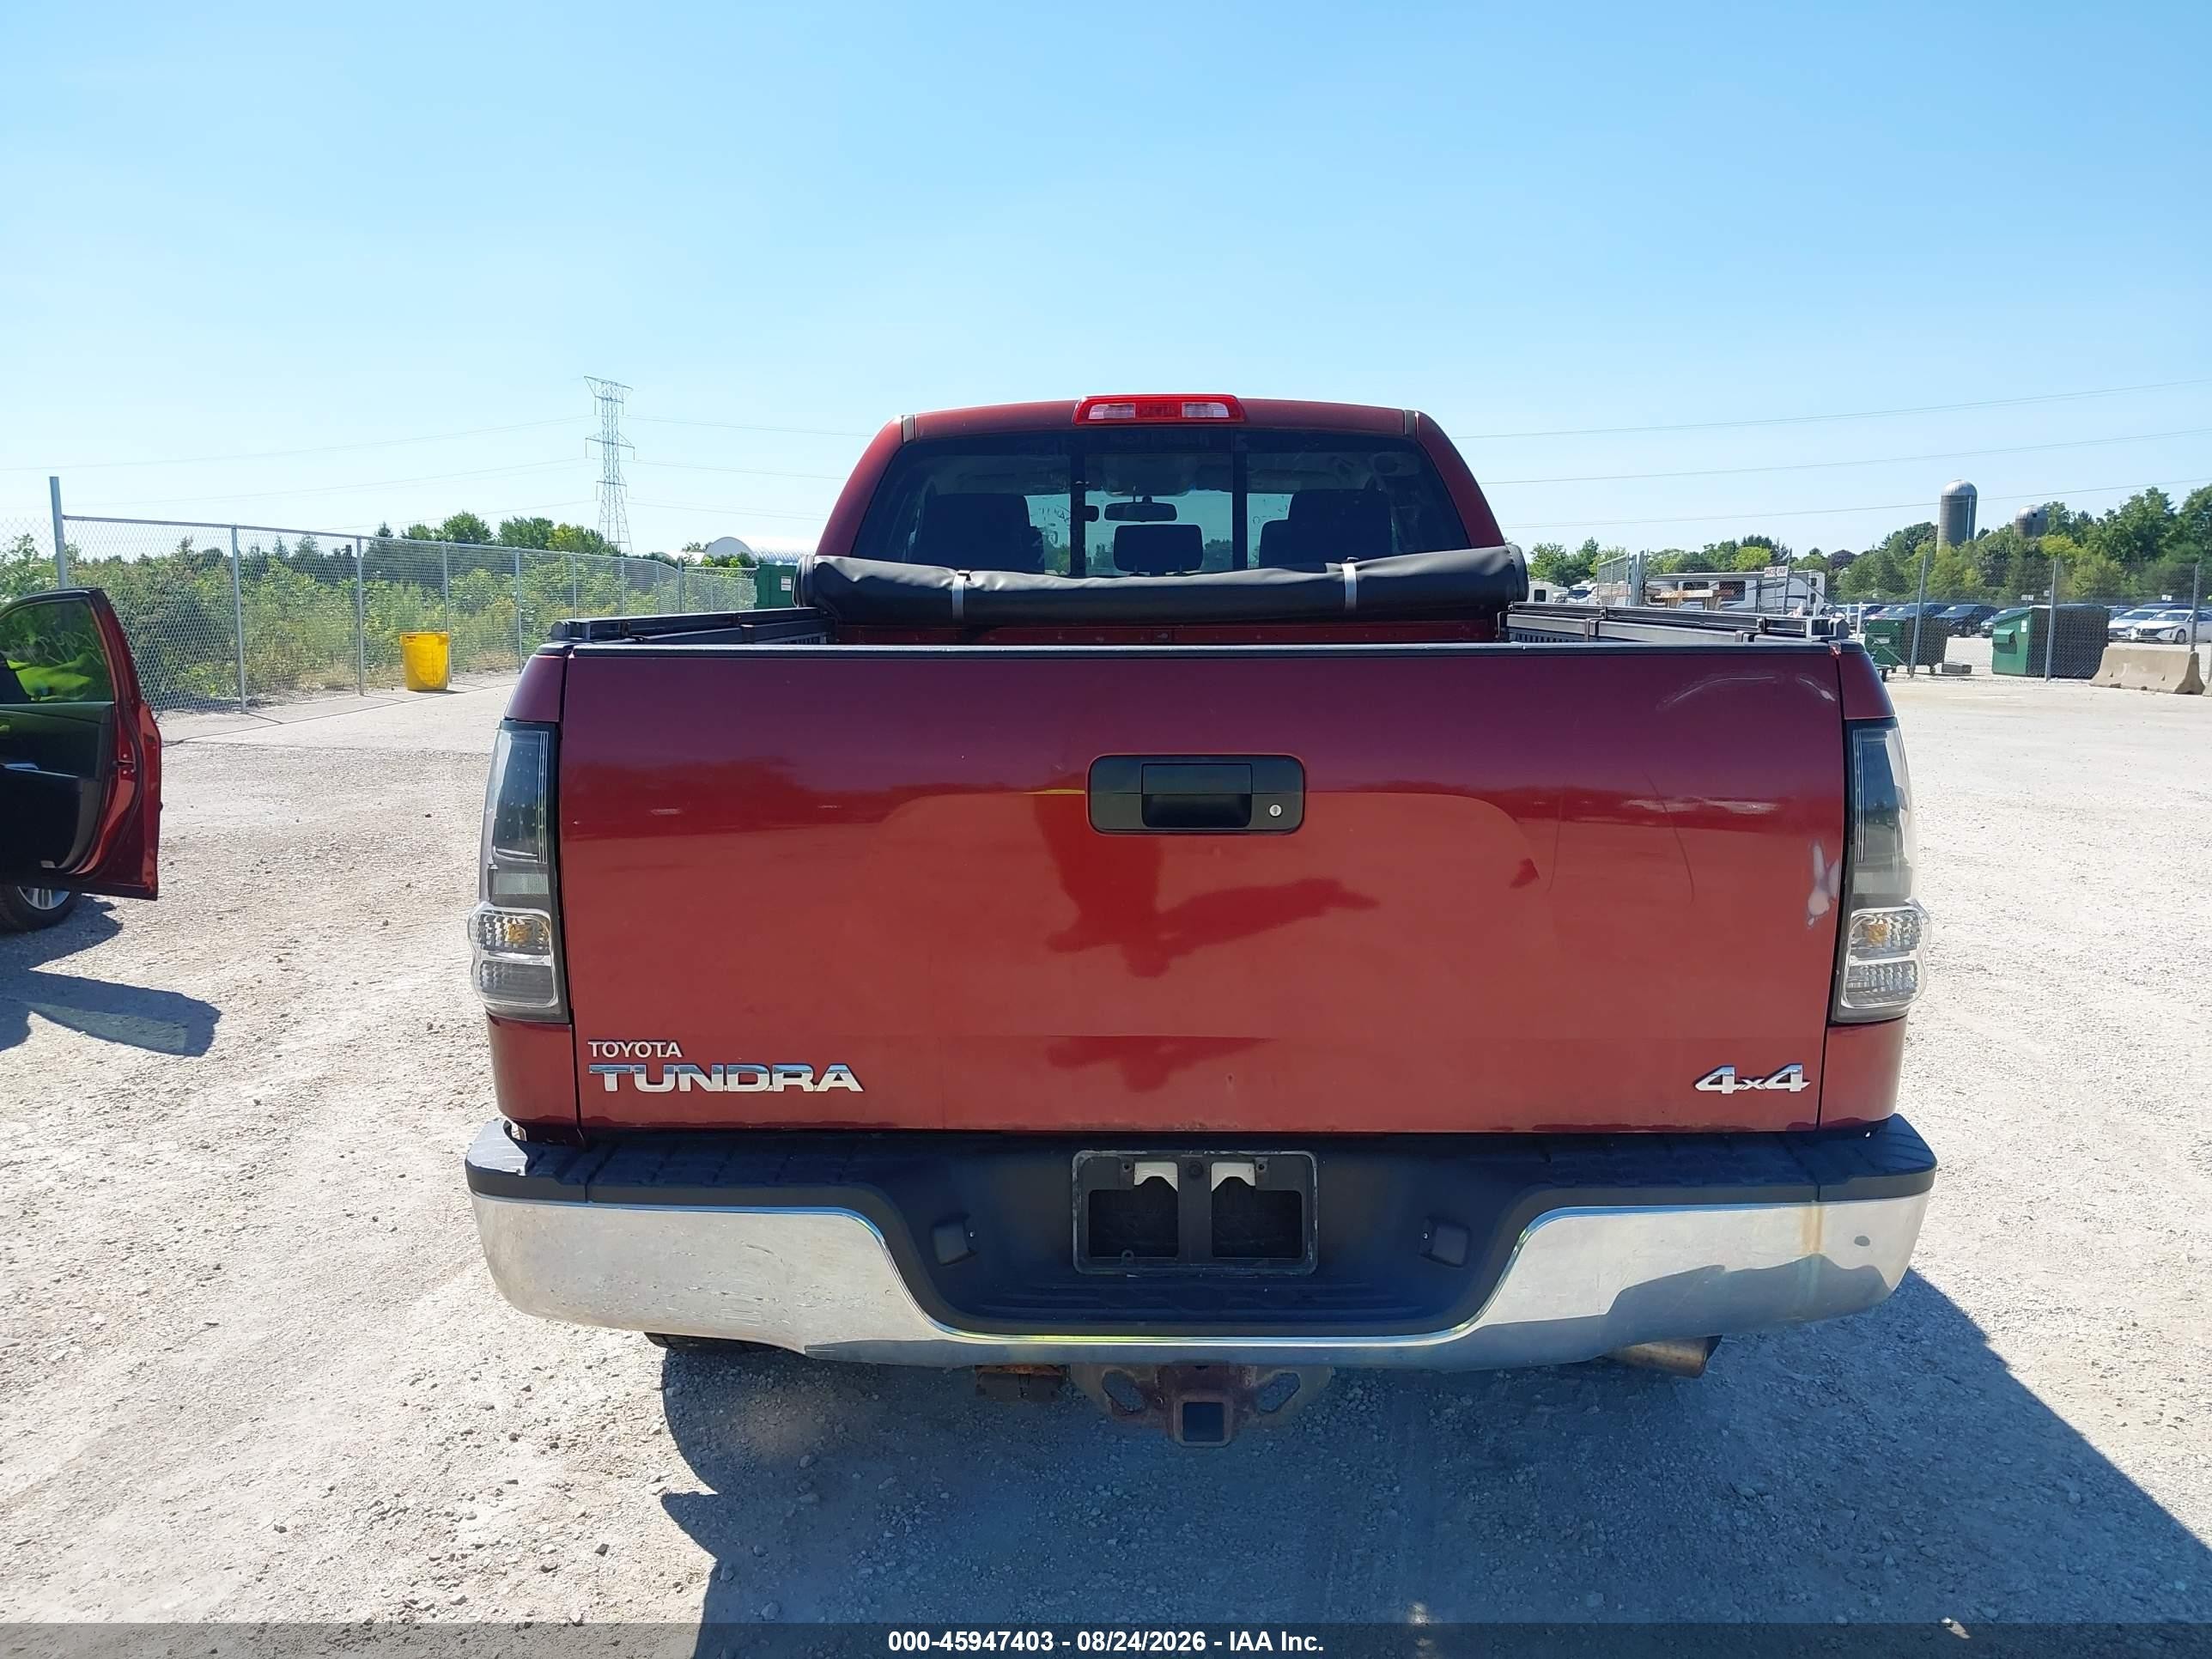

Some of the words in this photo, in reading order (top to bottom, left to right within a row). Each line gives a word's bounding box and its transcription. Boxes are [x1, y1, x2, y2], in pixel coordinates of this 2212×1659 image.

[587, 1041, 683, 1058] TOYOTA
[588, 1064, 865, 1092] TUNDRA
[1694, 1064, 1811, 1094] 4x4
